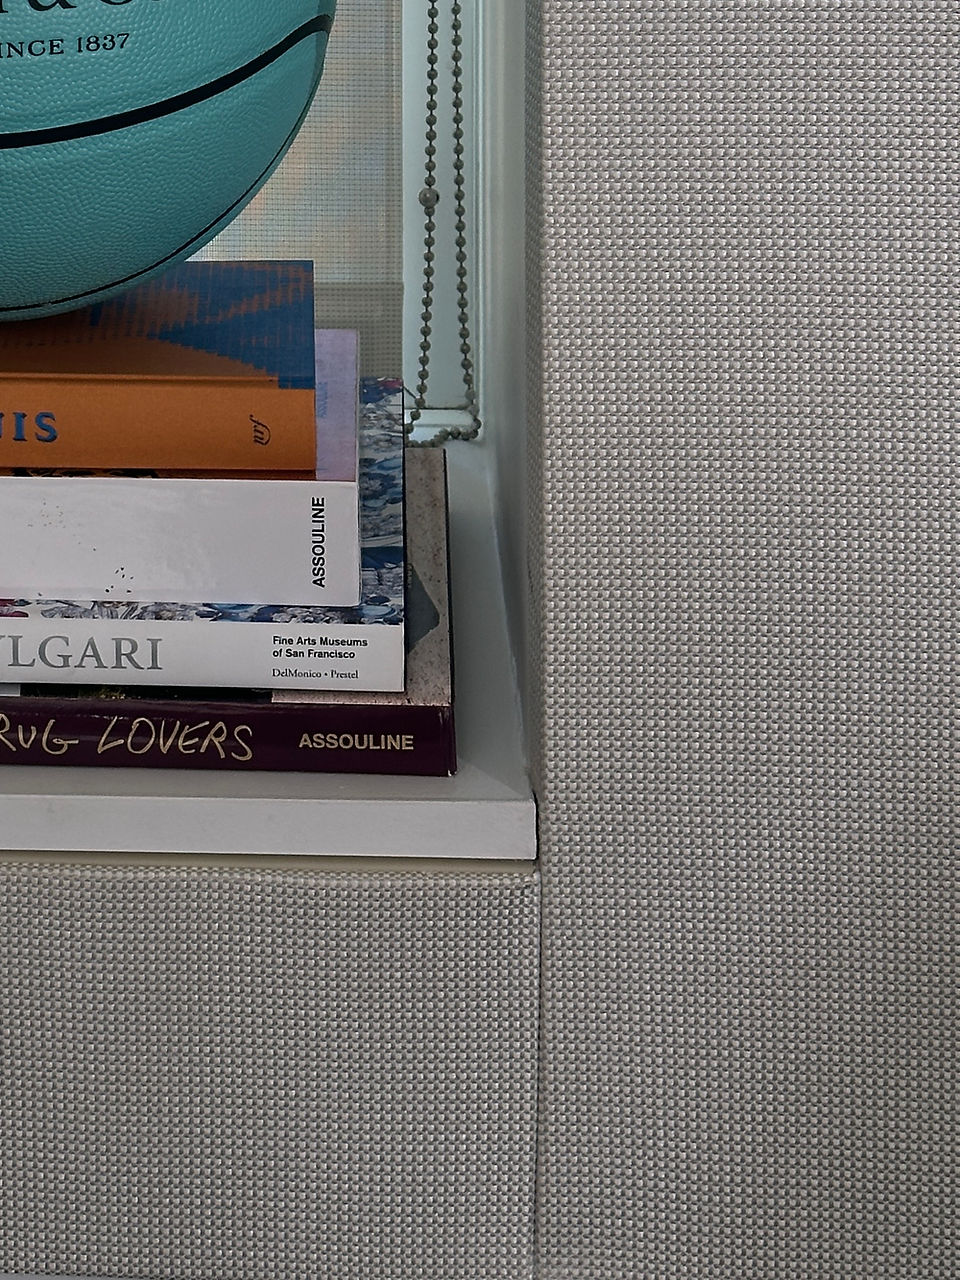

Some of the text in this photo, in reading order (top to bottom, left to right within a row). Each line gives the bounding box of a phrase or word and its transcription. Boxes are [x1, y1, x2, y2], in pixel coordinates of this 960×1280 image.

[76, 33, 131, 53] 1837
[311, 496, 327, 588] ASSOULINE
[272, 635, 368, 647] Fine Arts Museums
[272, 649, 356, 659] of San Francisco
[272, 668, 359, 680] DelMonico Prestel
[97, 718, 254, 762] LOVERS
[298, 732, 415, 751] ASSOULINE
